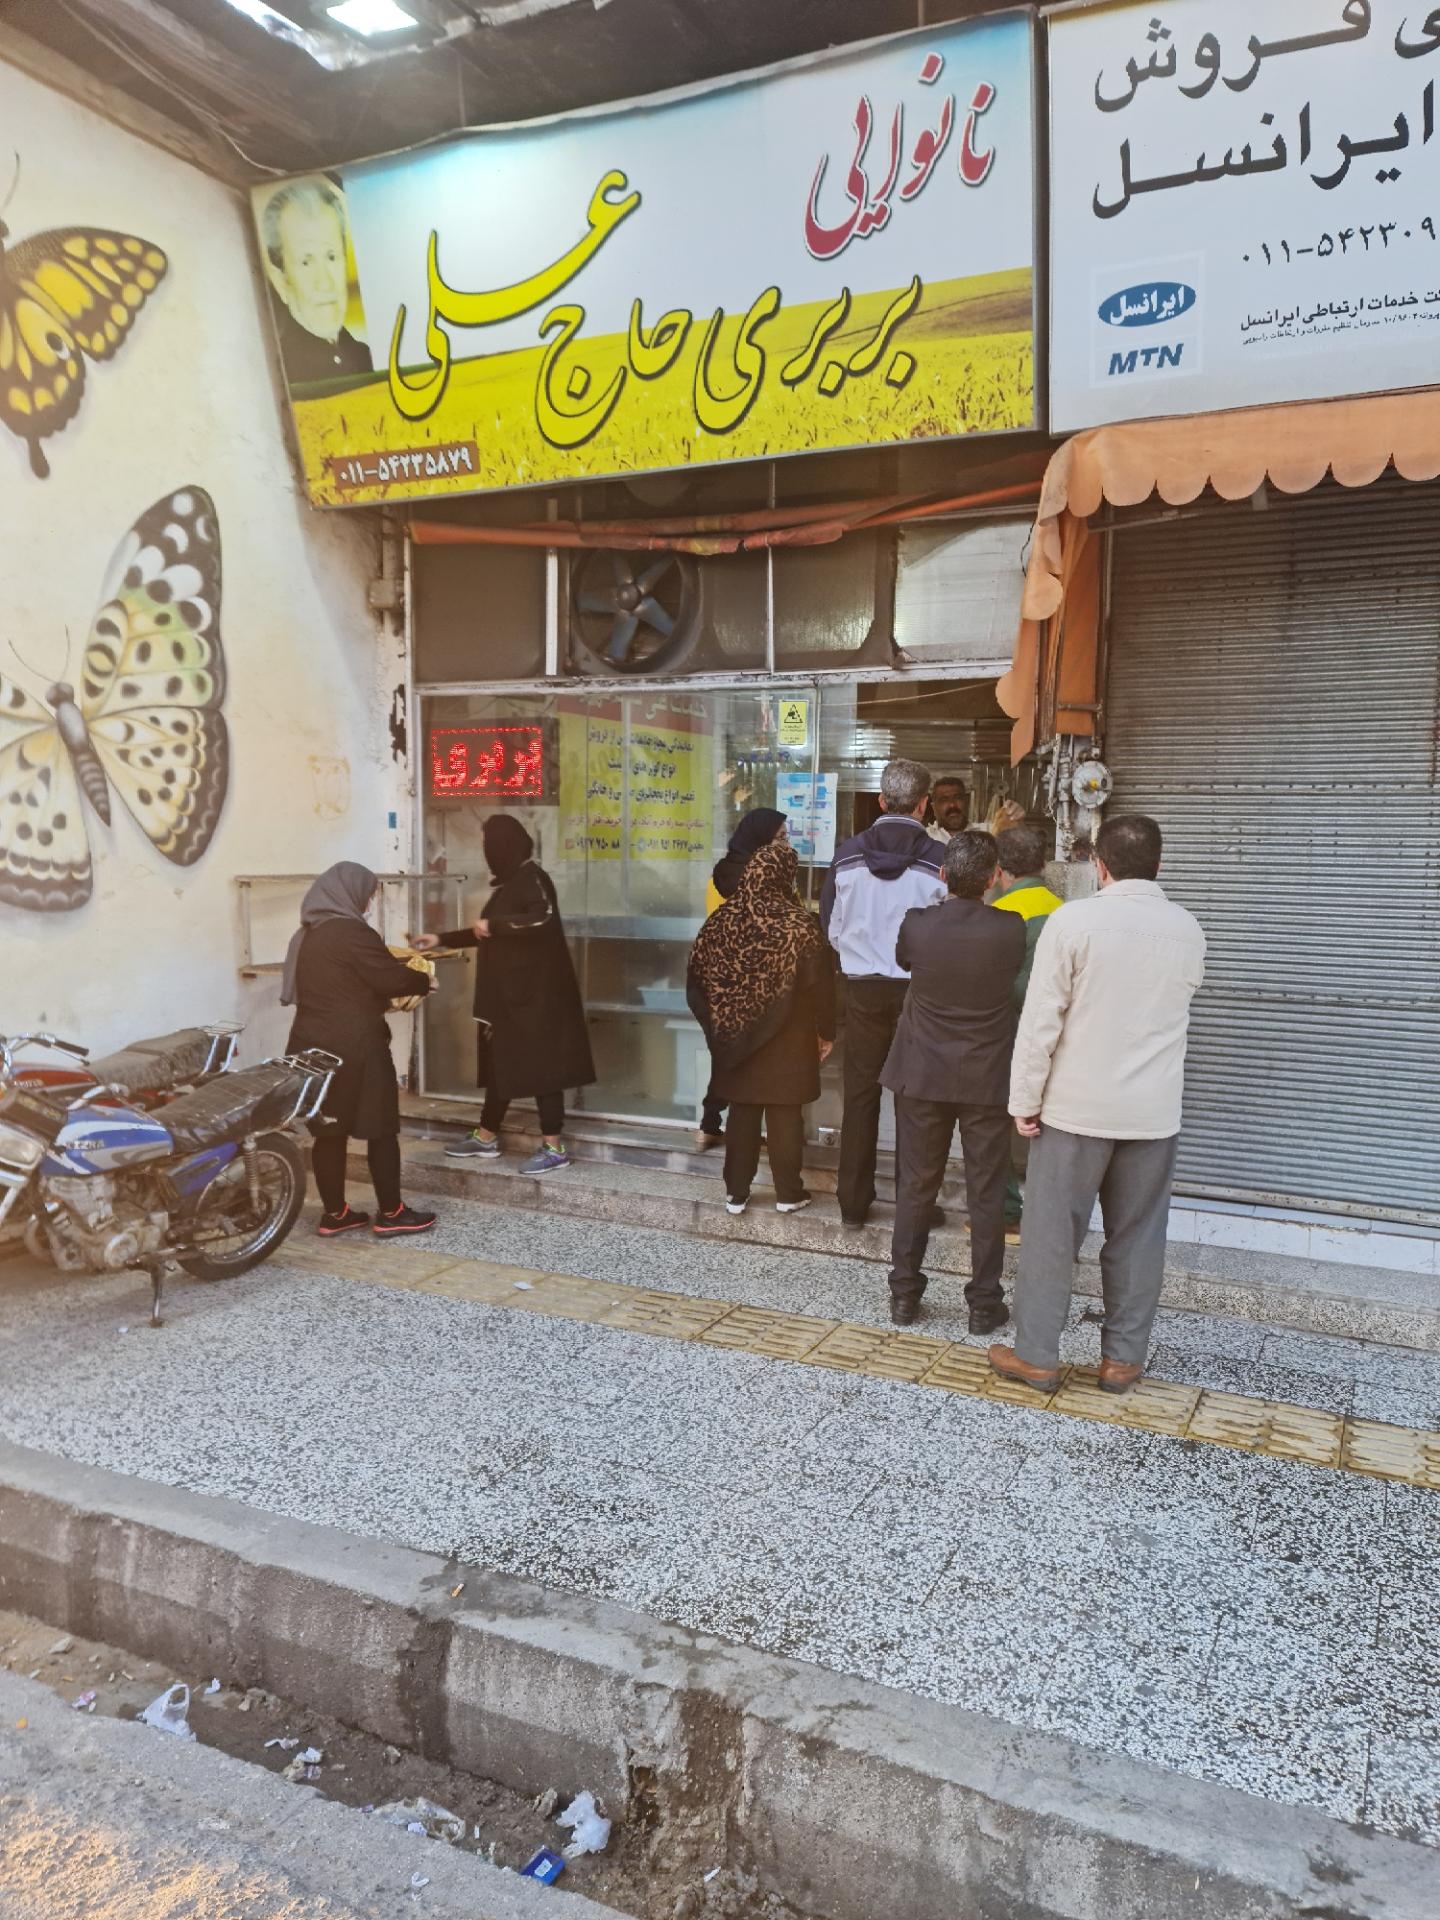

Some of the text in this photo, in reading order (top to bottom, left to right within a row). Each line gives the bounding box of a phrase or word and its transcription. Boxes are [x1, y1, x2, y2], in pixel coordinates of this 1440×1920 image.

[1094, 0, 1372, 112] فروش
[804, 52, 996, 260] نانوایی
[1092, 78, 1434, 219] ایرانسل
[388, 168, 922, 448] بربری حاج علی
[1109, 286, 1186, 325] ایرانسل
[1240, 306, 1300, 331] ایرانسل
[1302, 297, 1364, 324] ارتباطی
[1367, 291, 1419, 311] خدمات
[1108, 343, 1184, 375] MTN
[432, 741, 542, 788] بربری
